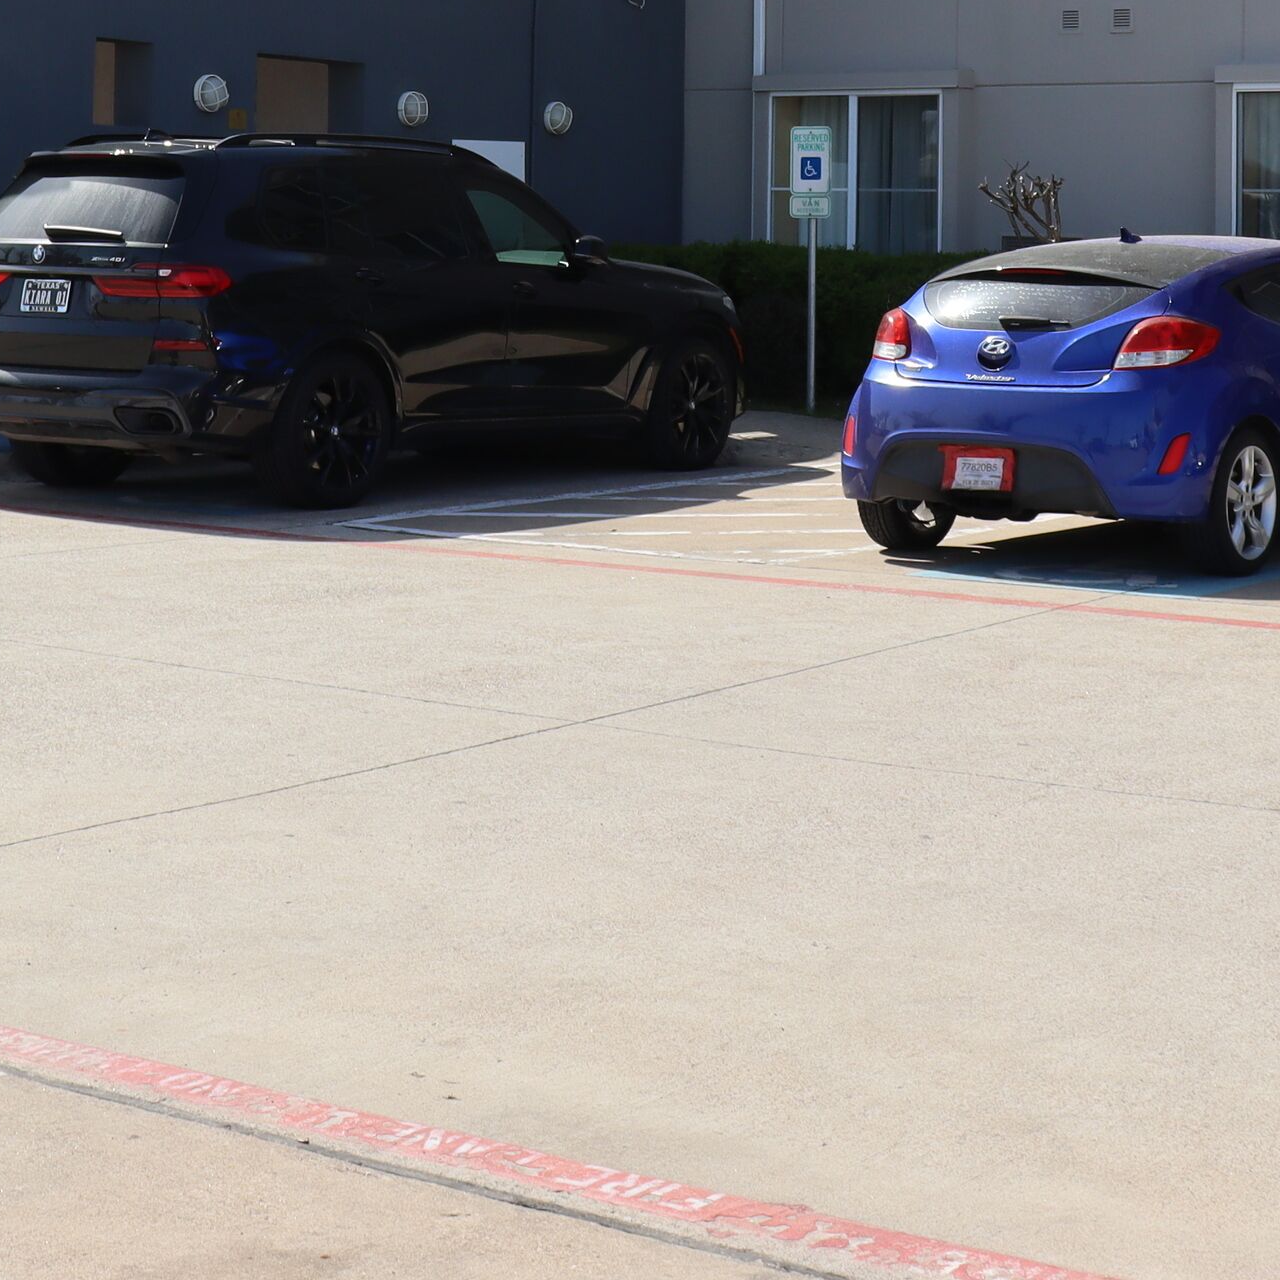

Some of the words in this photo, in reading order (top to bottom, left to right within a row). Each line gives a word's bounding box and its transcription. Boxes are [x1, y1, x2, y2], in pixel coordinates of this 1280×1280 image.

[793, 133, 829, 142] RESERVED
[797, 142, 826, 152] PARKING
[801, 199, 820, 207] VAN
[37, 281, 60, 289] TEXAS
[24, 289, 52, 305] KIARA
[552, 1163, 726, 1211] FIRE
